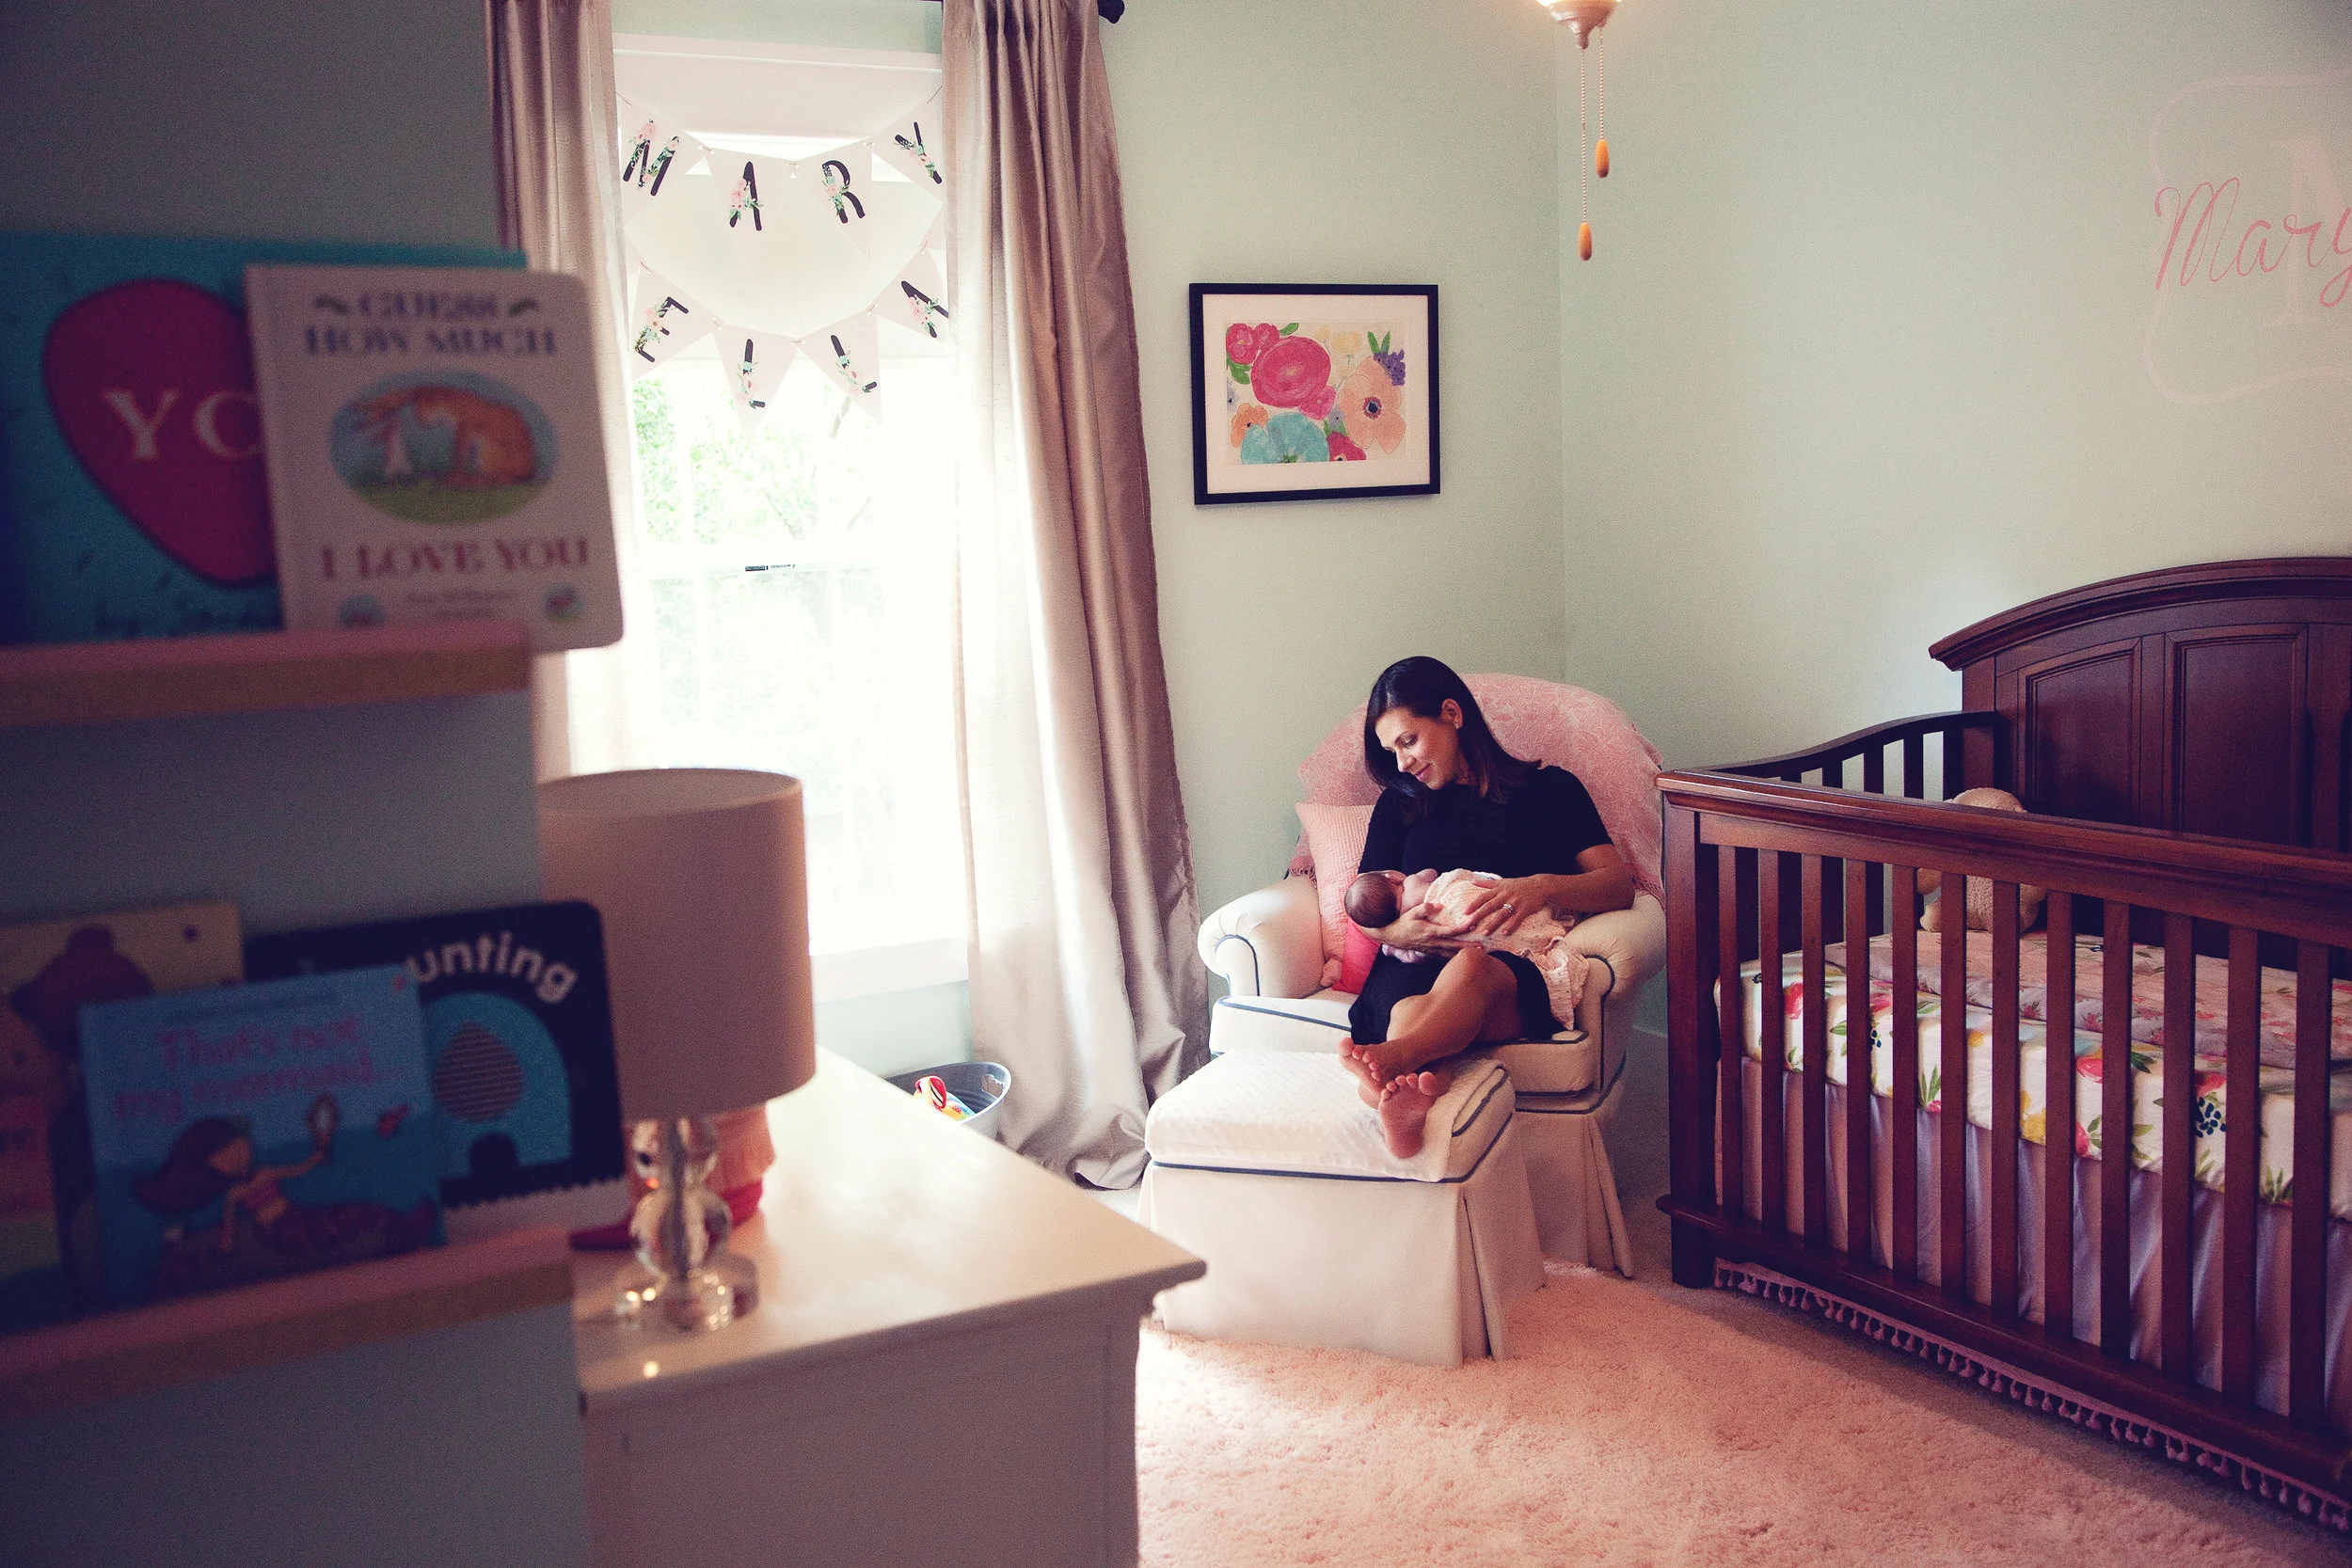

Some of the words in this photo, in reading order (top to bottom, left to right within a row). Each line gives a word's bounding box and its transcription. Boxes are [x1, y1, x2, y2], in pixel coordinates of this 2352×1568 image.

[623, 119, 942, 231] MARY
[2153, 176, 2352, 309] Mary
[304, 325, 408, 356] HOW
[426, 325, 556, 356] MUCH
[358, 292, 498, 318] GUESS
[633, 280, 948, 408] ELLA
[104, 388, 264, 461] YO
[321, 546, 335, 579] I
[357, 541, 483, 578] LOVE
[494, 536, 591, 571] YOU
[405, 931, 579, 1005] unting
